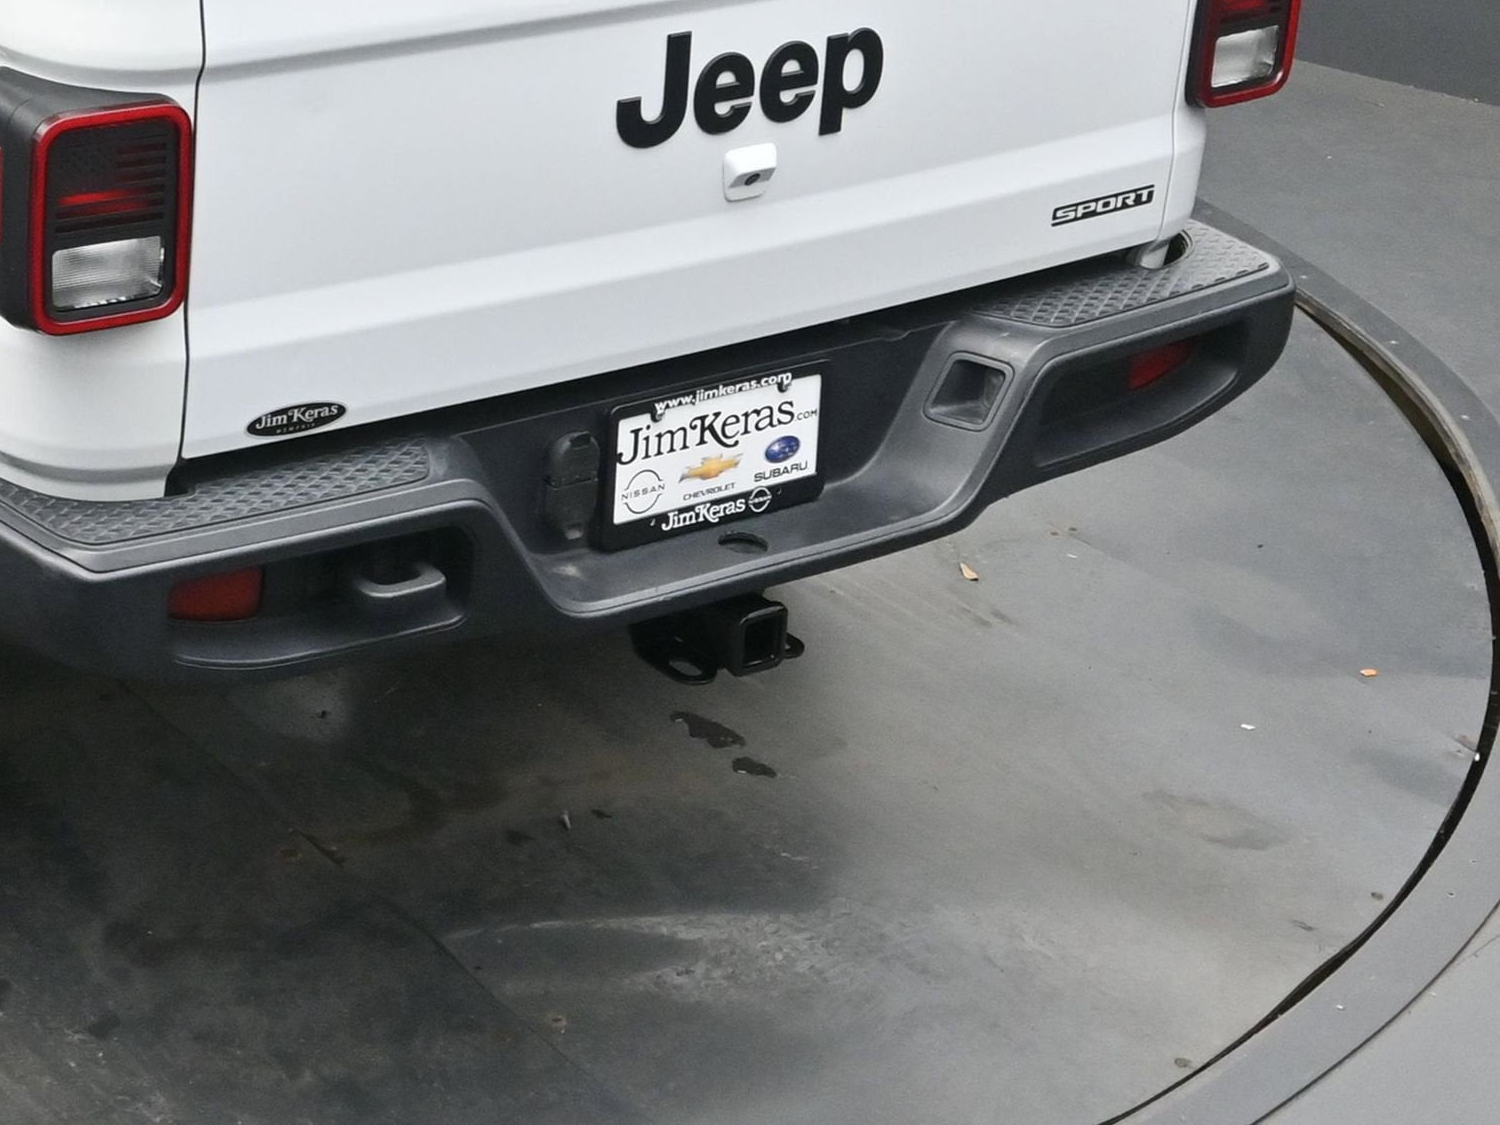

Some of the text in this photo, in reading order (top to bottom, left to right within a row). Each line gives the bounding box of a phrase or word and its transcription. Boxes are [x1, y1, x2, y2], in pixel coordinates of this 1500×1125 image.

[616, 27, 884, 149] Jeep
[1052, 187, 1155, 225] SPORT
[654, 371, 793, 413] www.jimkeras.com
[753, 460, 809, 483] SUBARU
[621, 482, 666, 501] NISSAN
[682, 482, 736, 501] CHEVROLET
